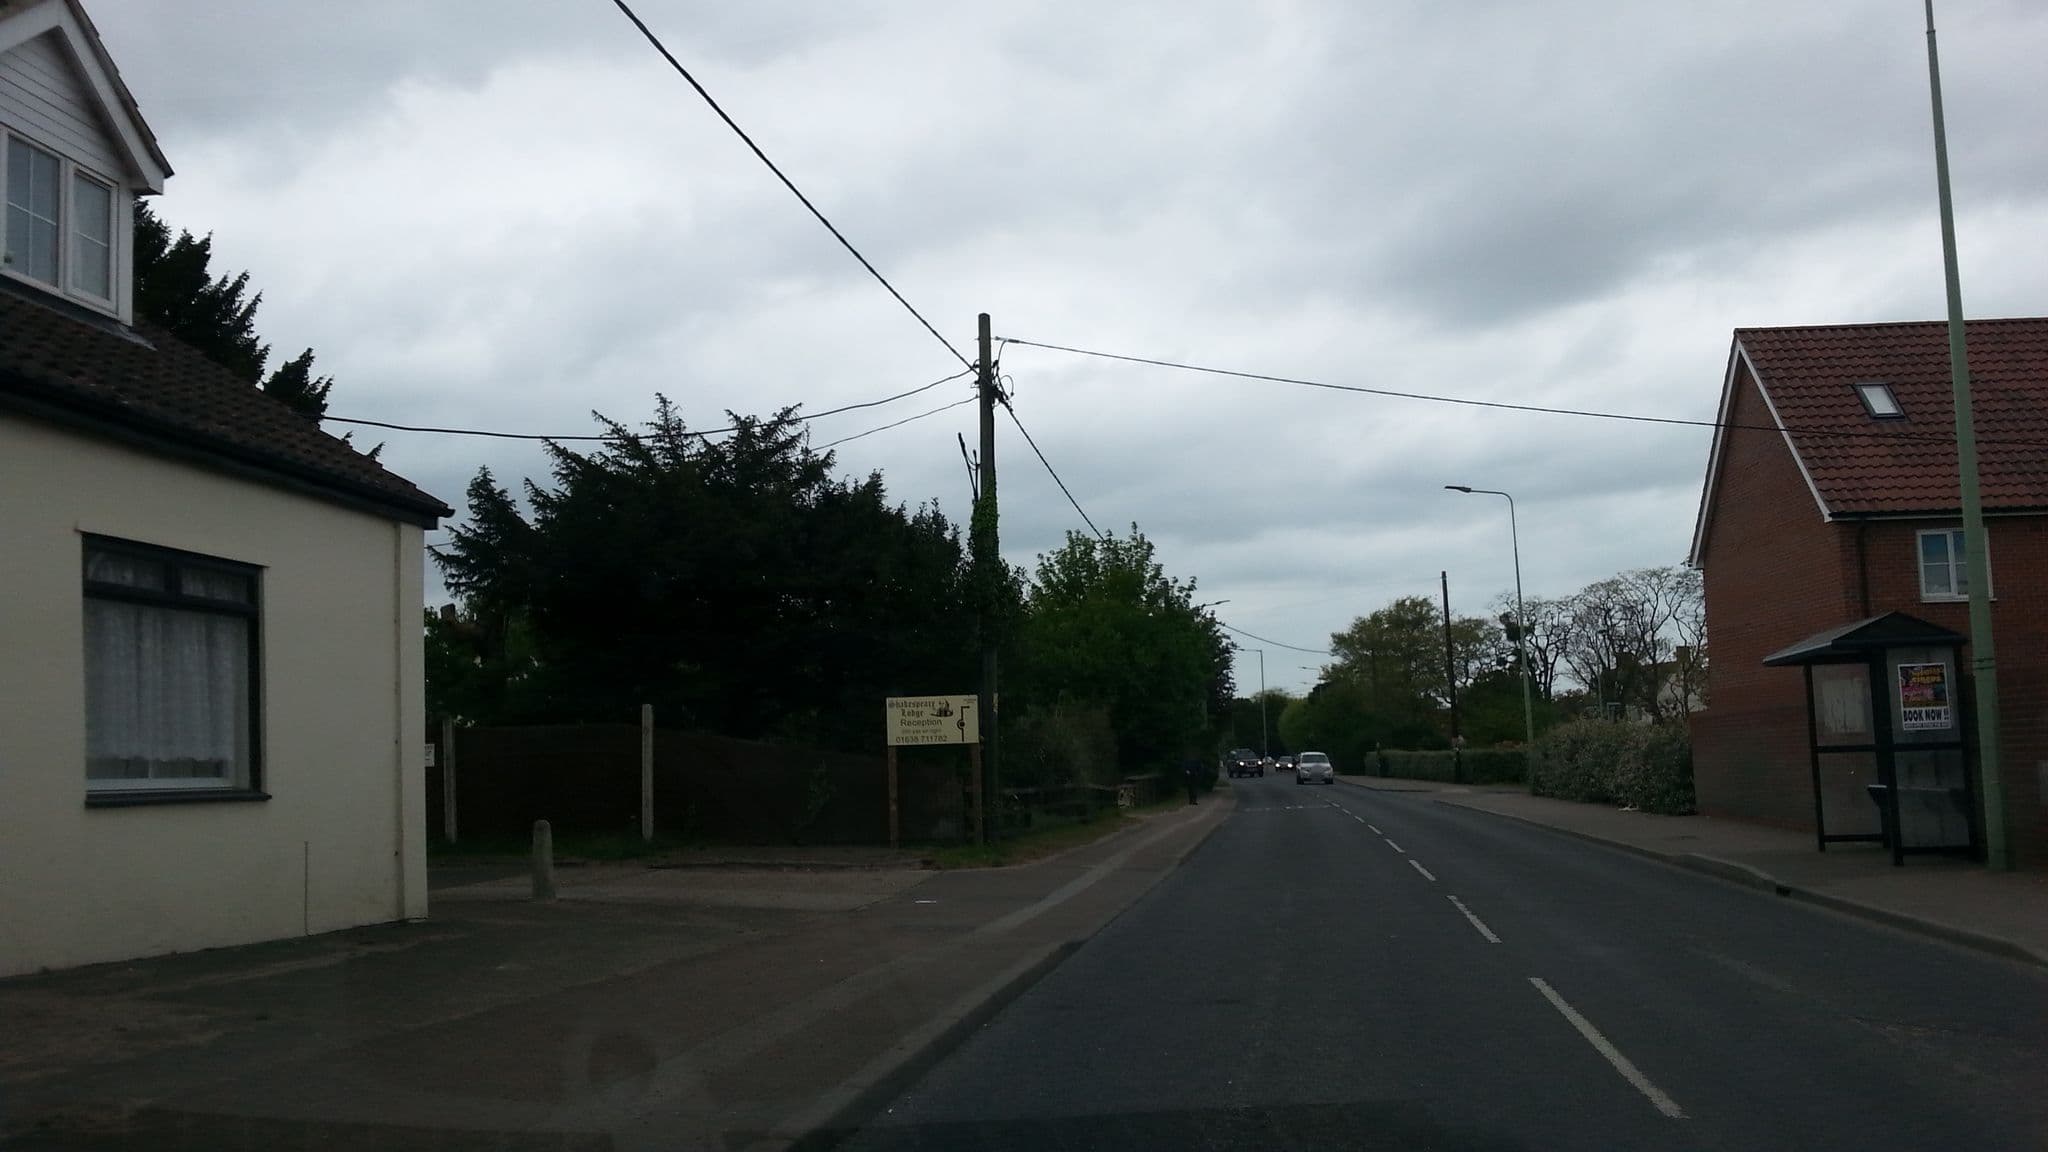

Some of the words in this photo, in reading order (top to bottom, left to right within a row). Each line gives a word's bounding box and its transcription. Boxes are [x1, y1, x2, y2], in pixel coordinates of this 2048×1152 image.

[1904, 710, 1924, 721] BOOK
[1925, 709, 1942, 721] NOW
[900, 719, 943, 728] Reception
